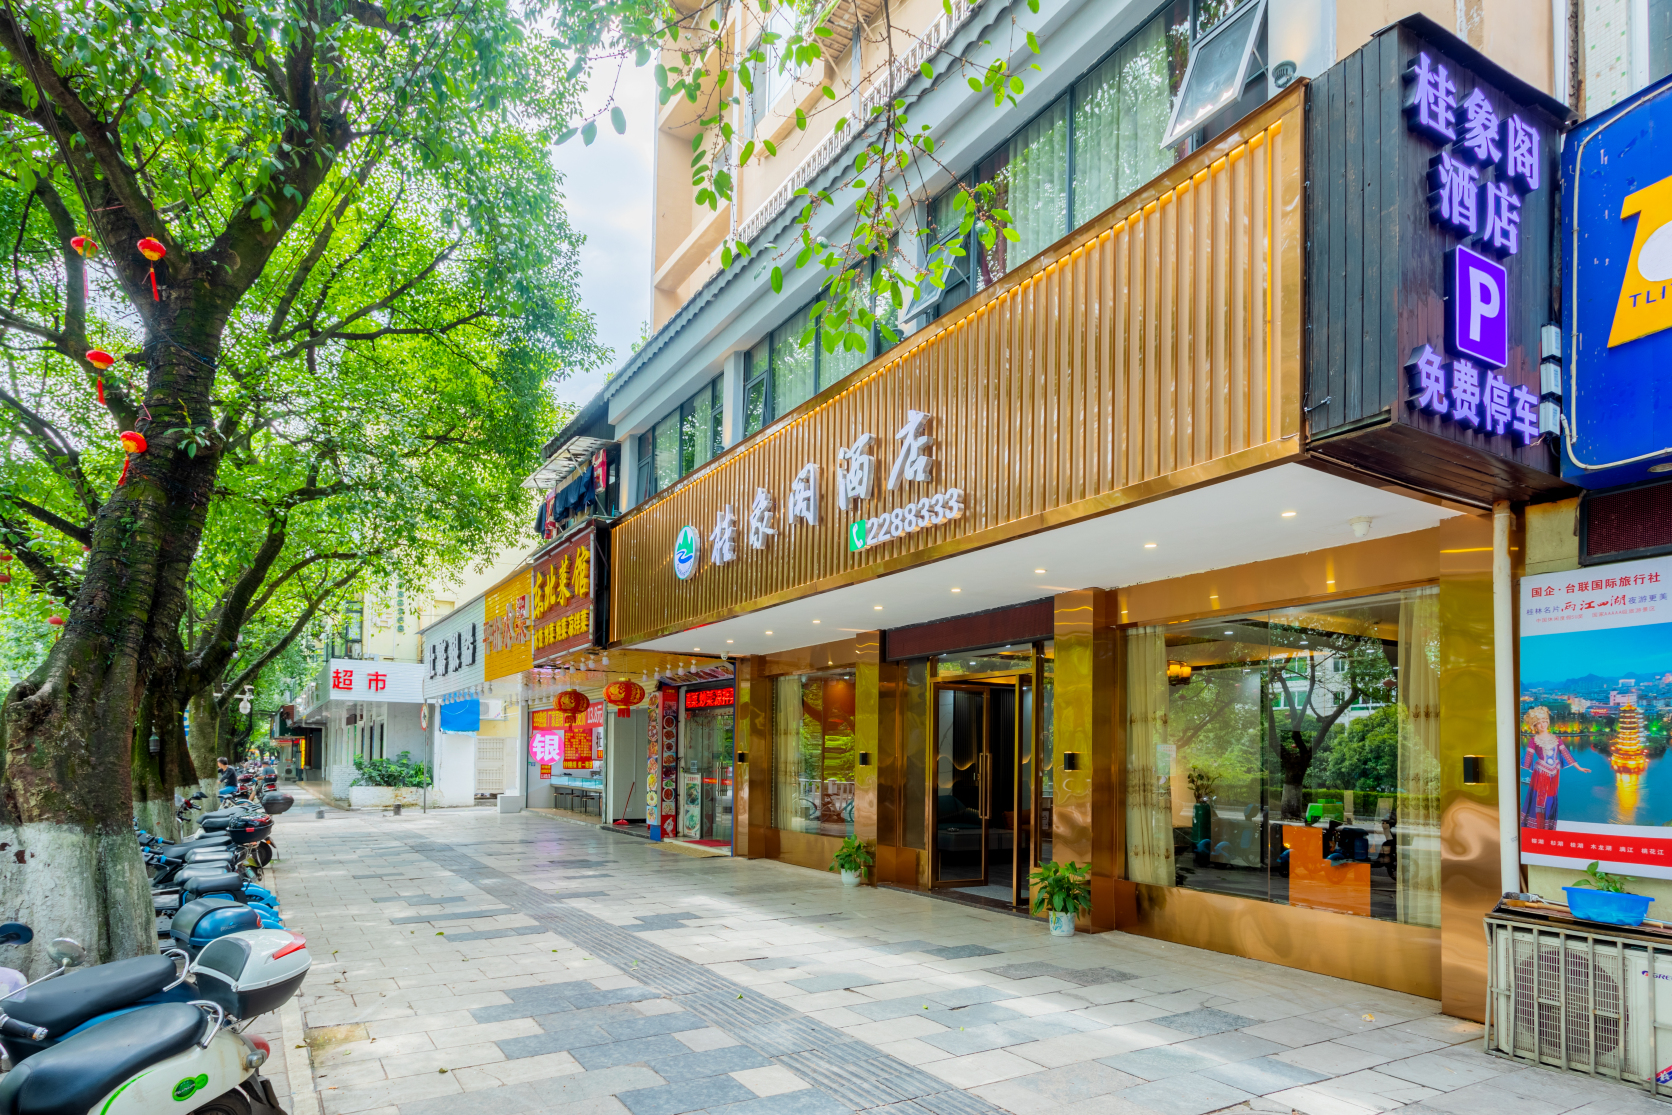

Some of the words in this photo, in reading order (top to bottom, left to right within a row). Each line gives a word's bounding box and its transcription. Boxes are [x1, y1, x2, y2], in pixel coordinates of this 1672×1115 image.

[1414, 52, 1540, 190] 桂象阁
[1439, 152, 1520, 255] 酒店
[1469, 266, 1500, 342] P
[1417, 344, 1540, 446] 免费停车
[709, 409, 934, 566] 桂象阁酒店
[867, 488, 964, 546] 2288333
[533, 545, 591, 620] 东北菜馆
[482, 594, 531, 655] 平价水果
[332, 669, 387, 692] 超市
[533, 733, 560, 761] 银
